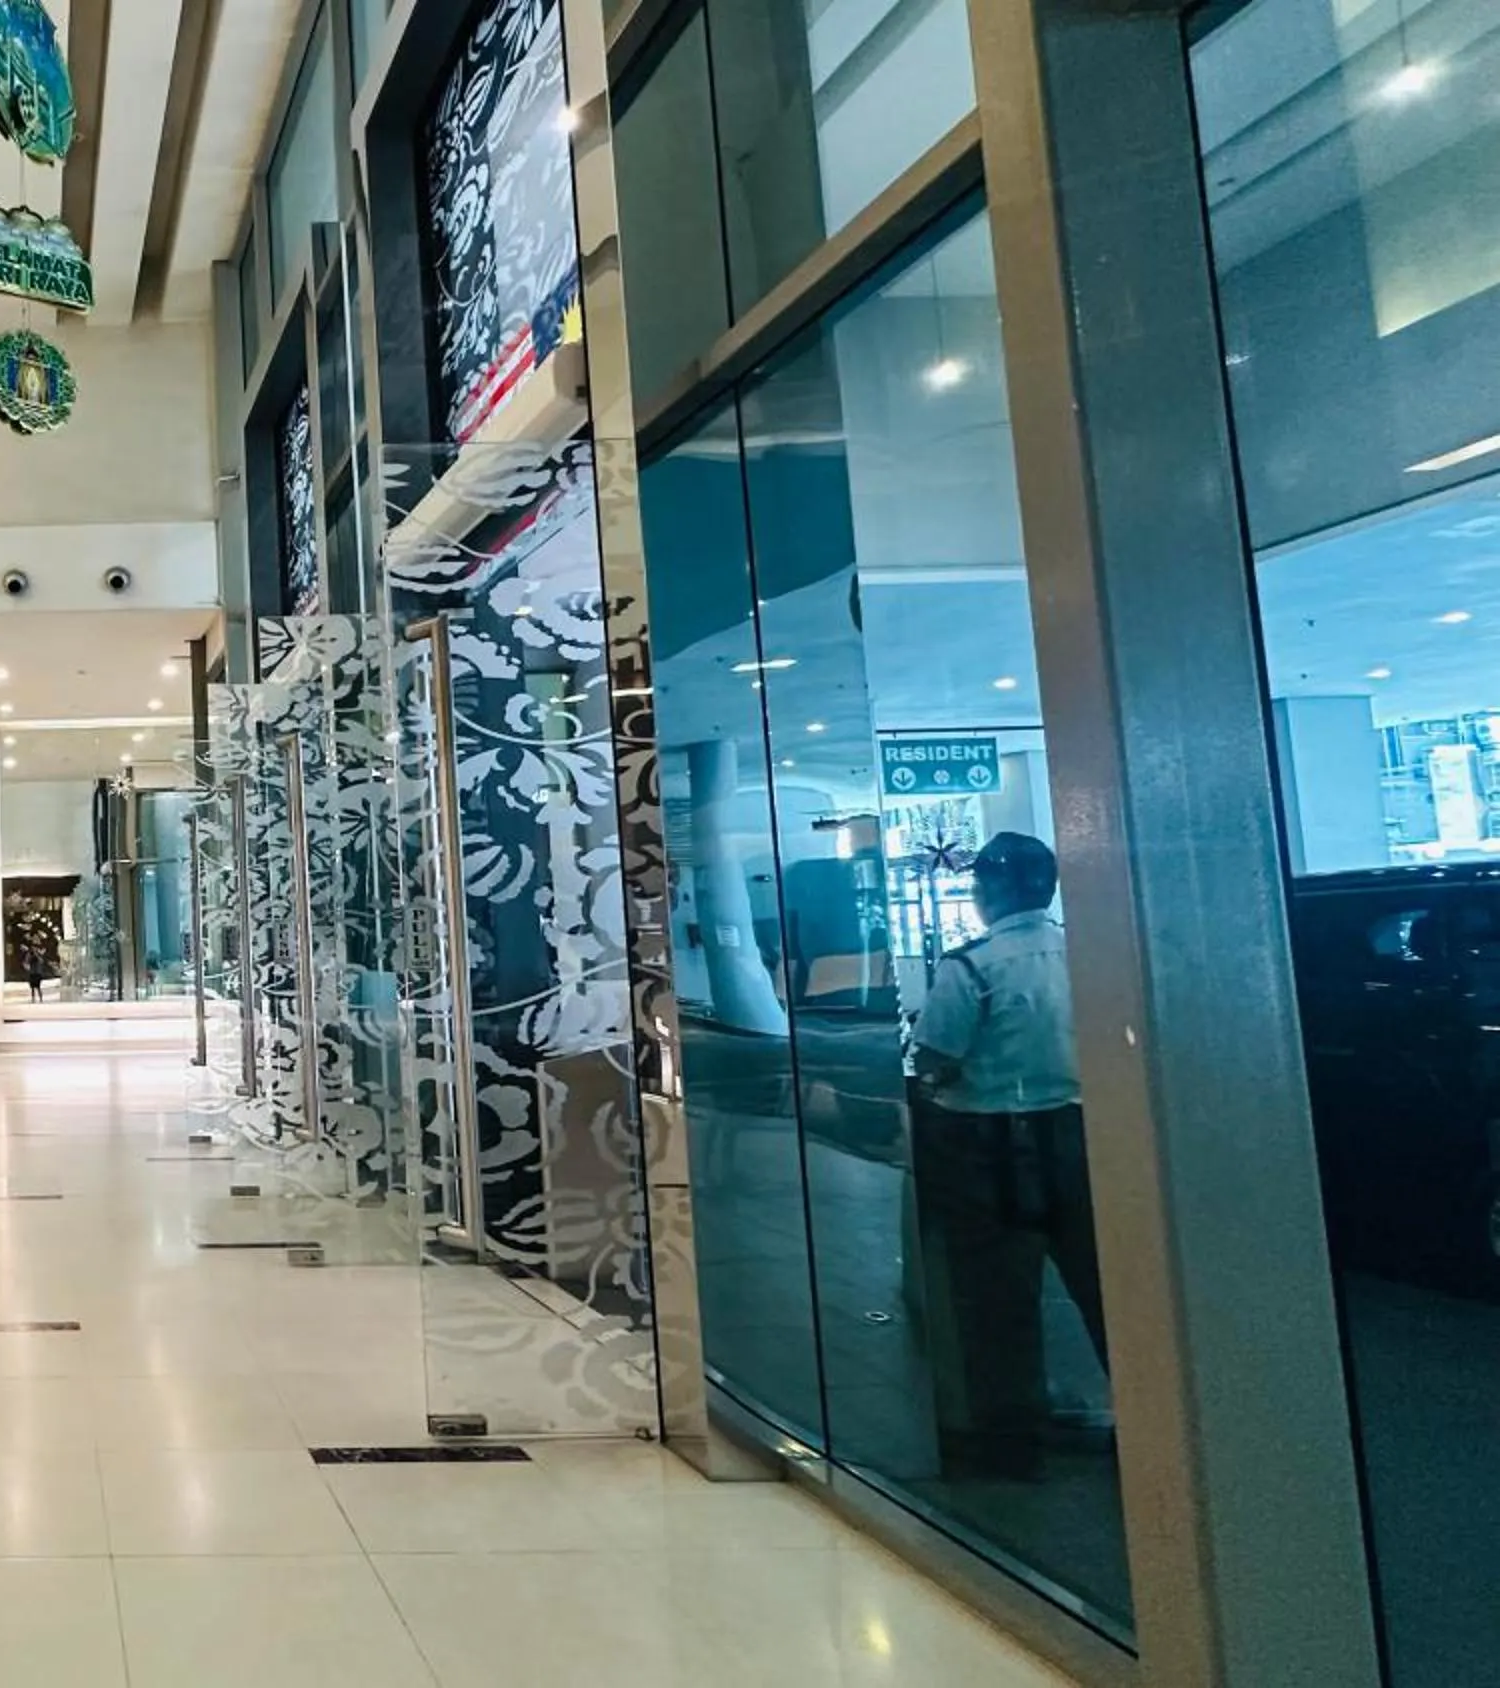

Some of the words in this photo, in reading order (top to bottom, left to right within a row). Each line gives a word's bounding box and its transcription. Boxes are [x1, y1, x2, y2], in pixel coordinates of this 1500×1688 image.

[28, 269, 90, 302] RAYA
[885, 745, 993, 761] RESIDENT
[279, 923, 289, 957] PUSH
[412, 909, 429, 958] PULL
